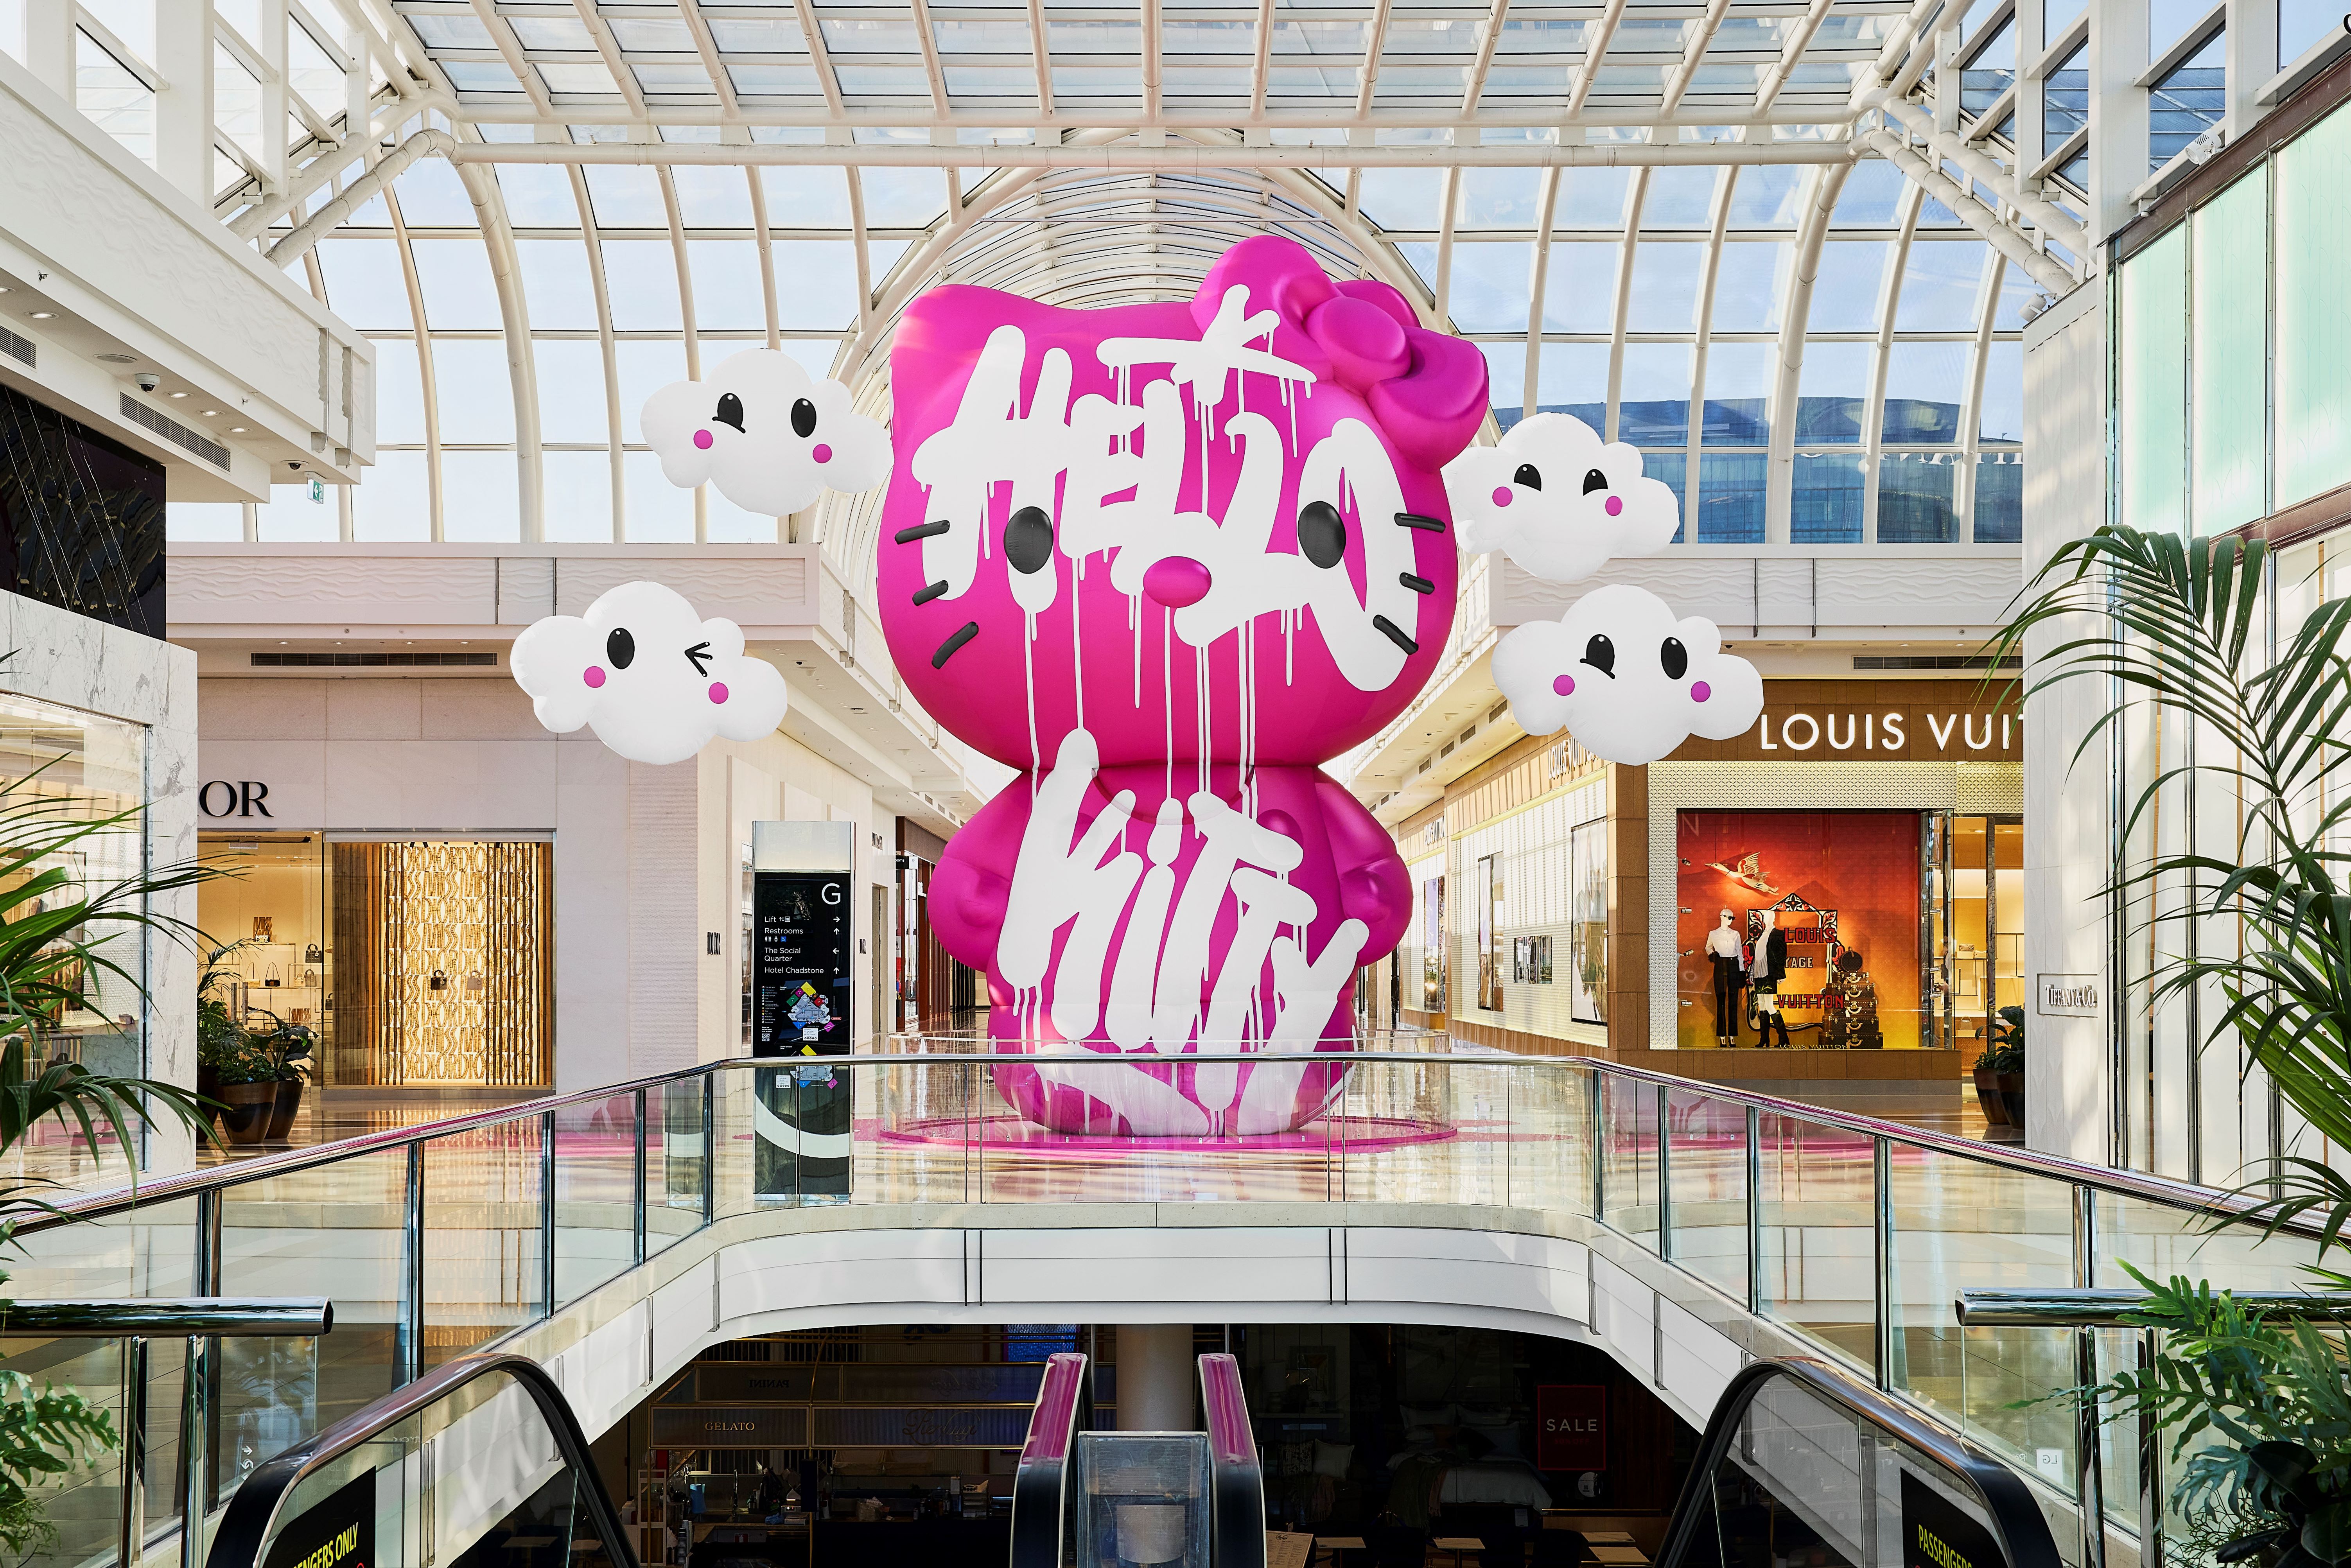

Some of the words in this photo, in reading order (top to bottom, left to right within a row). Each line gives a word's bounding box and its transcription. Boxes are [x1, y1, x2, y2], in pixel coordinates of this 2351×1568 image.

[1761, 713, 1904, 750] LOUIS
[1927, 713, 2023, 751] VUI
[197, 780, 274, 818] OR
[822, 883, 841, 904] G
[1784, 928, 1836, 943] LOUIS
[1777, 994, 1845, 1009] VUITTON
[705, 1422, 755, 1431] GELATO
[1546, 1419, 1597, 1432] SALE
[336, 1522, 358, 1561] ONLY
[1918, 1524, 1972, 1568] PASSENGE
